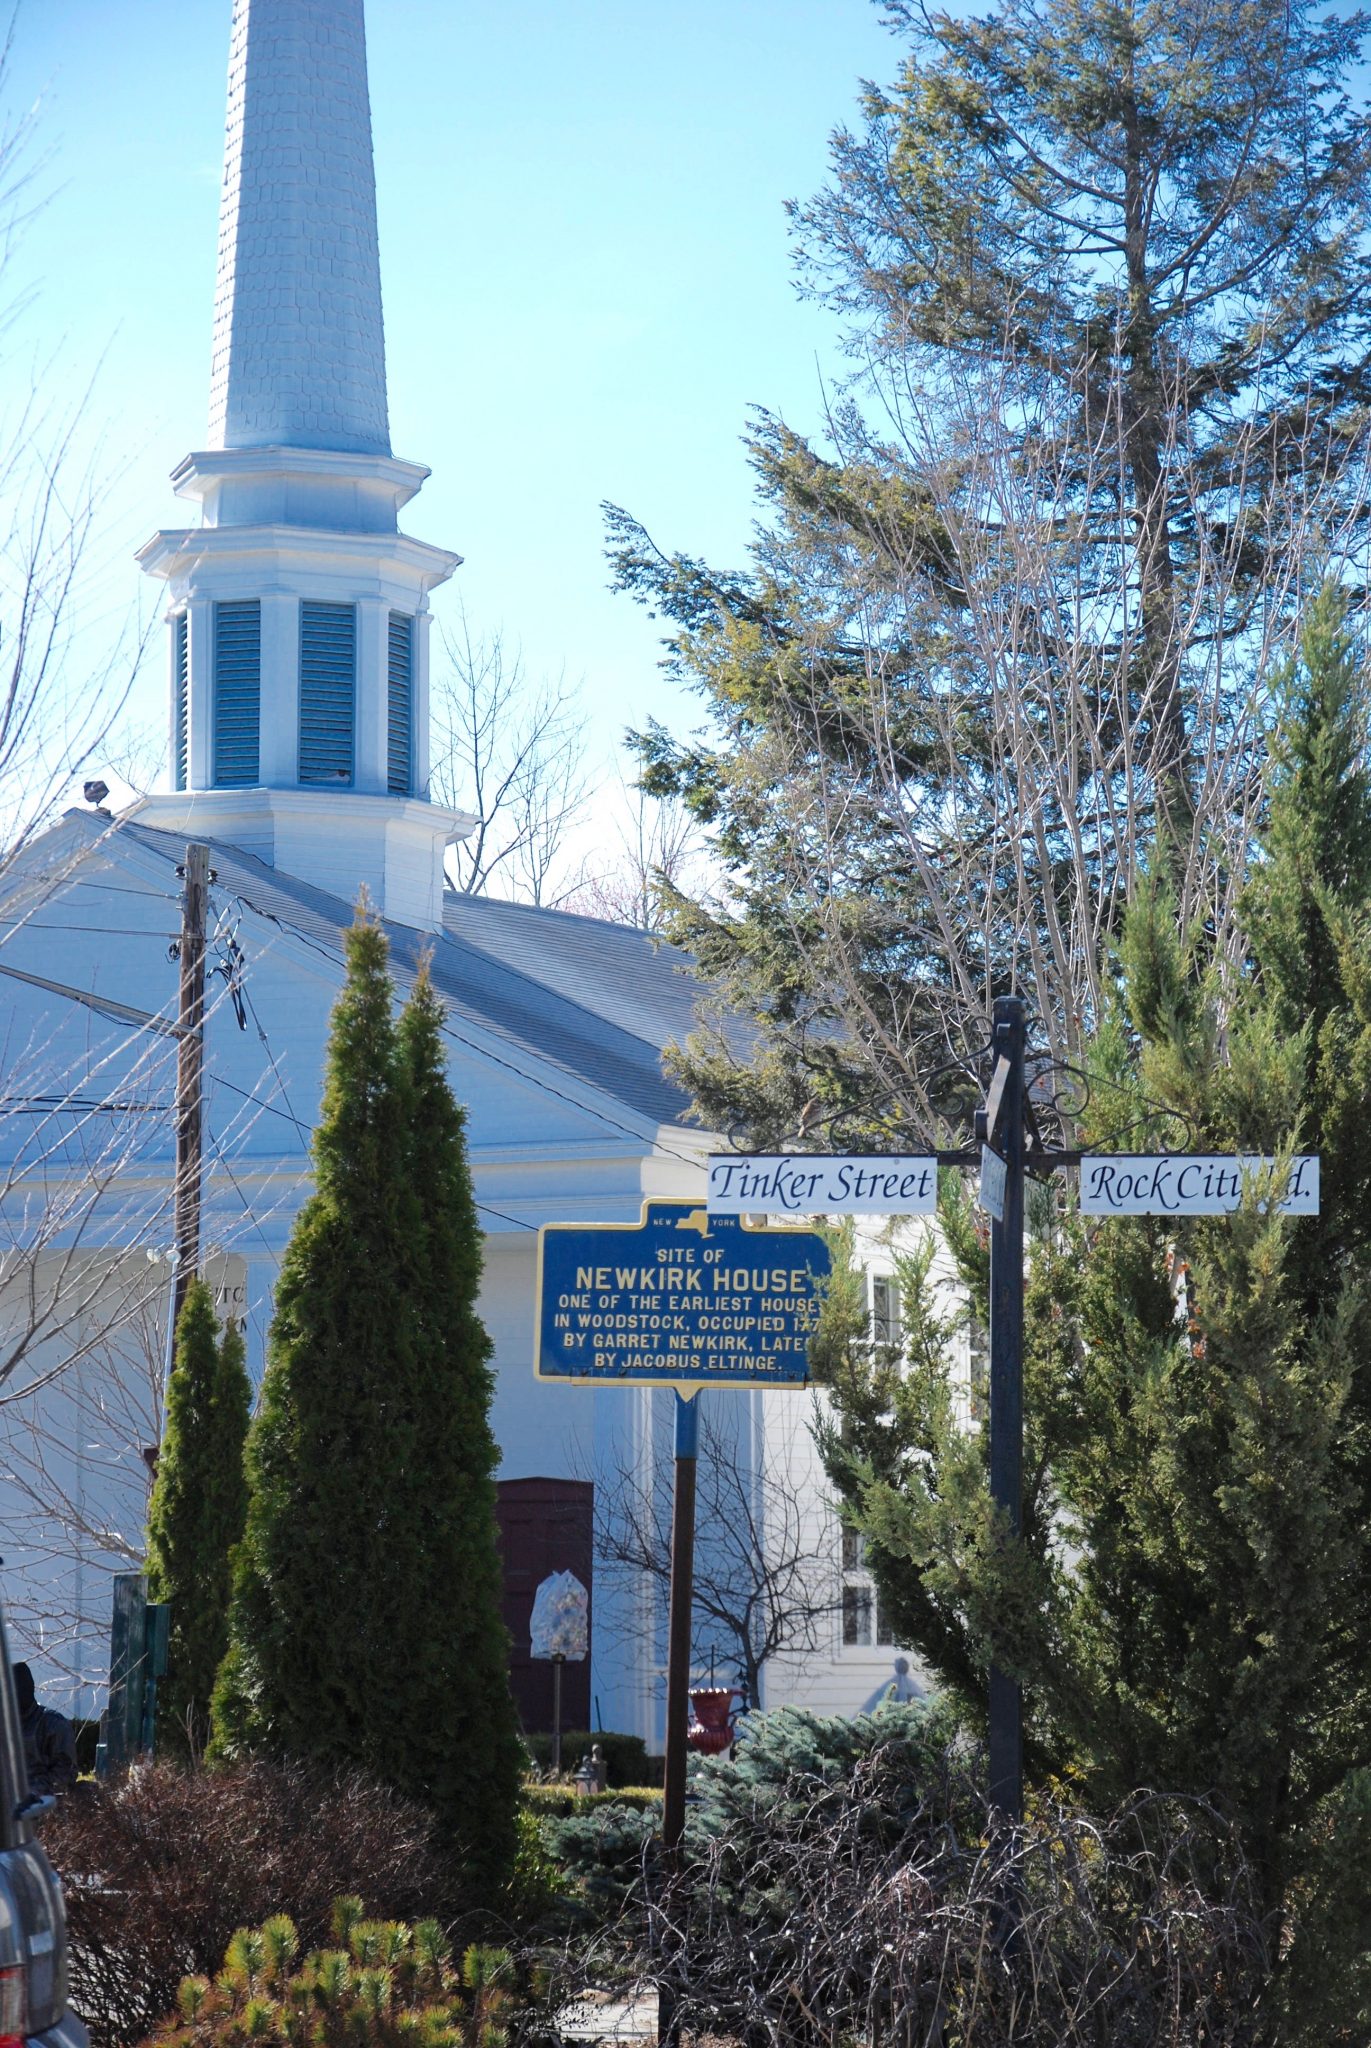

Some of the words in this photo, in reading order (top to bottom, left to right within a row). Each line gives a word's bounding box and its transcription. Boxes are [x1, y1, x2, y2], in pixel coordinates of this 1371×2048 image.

[711, 1159, 824, 1209] Tinker
[828, 1165, 932, 1201] Street
[1089, 1159, 1180, 1209] Rock
[656, 1249, 695, 1263] SITE
[703, 1249, 725, 1262] OF
[576, 1267, 702, 1291] NEWKIRK
[713, 1269, 807, 1292] HOUSE
[559, 1295, 591, 1309] ONE
[598, 1295, 620, 1309] OF
[630, 1296, 661, 1310] THE
[669, 1297, 752, 1311] EARLIEST
[761, 1298, 823, 1312] HOUSE
[555, 1314, 570, 1328] IN
[578, 1315, 690, 1332] WOODSTOCK,
[698, 1316, 785, 1331] OCCUPIED
[564, 1333, 585, 1347] BY
[593, 1334, 660, 1348] GARRET
[669, 1336, 753, 1352] NEWKIRK,
[594, 1353, 615, 1367] BY
[622, 1354, 700, 1368] JACOBUS
[708, 1356, 783, 1370] ELTINGE.
